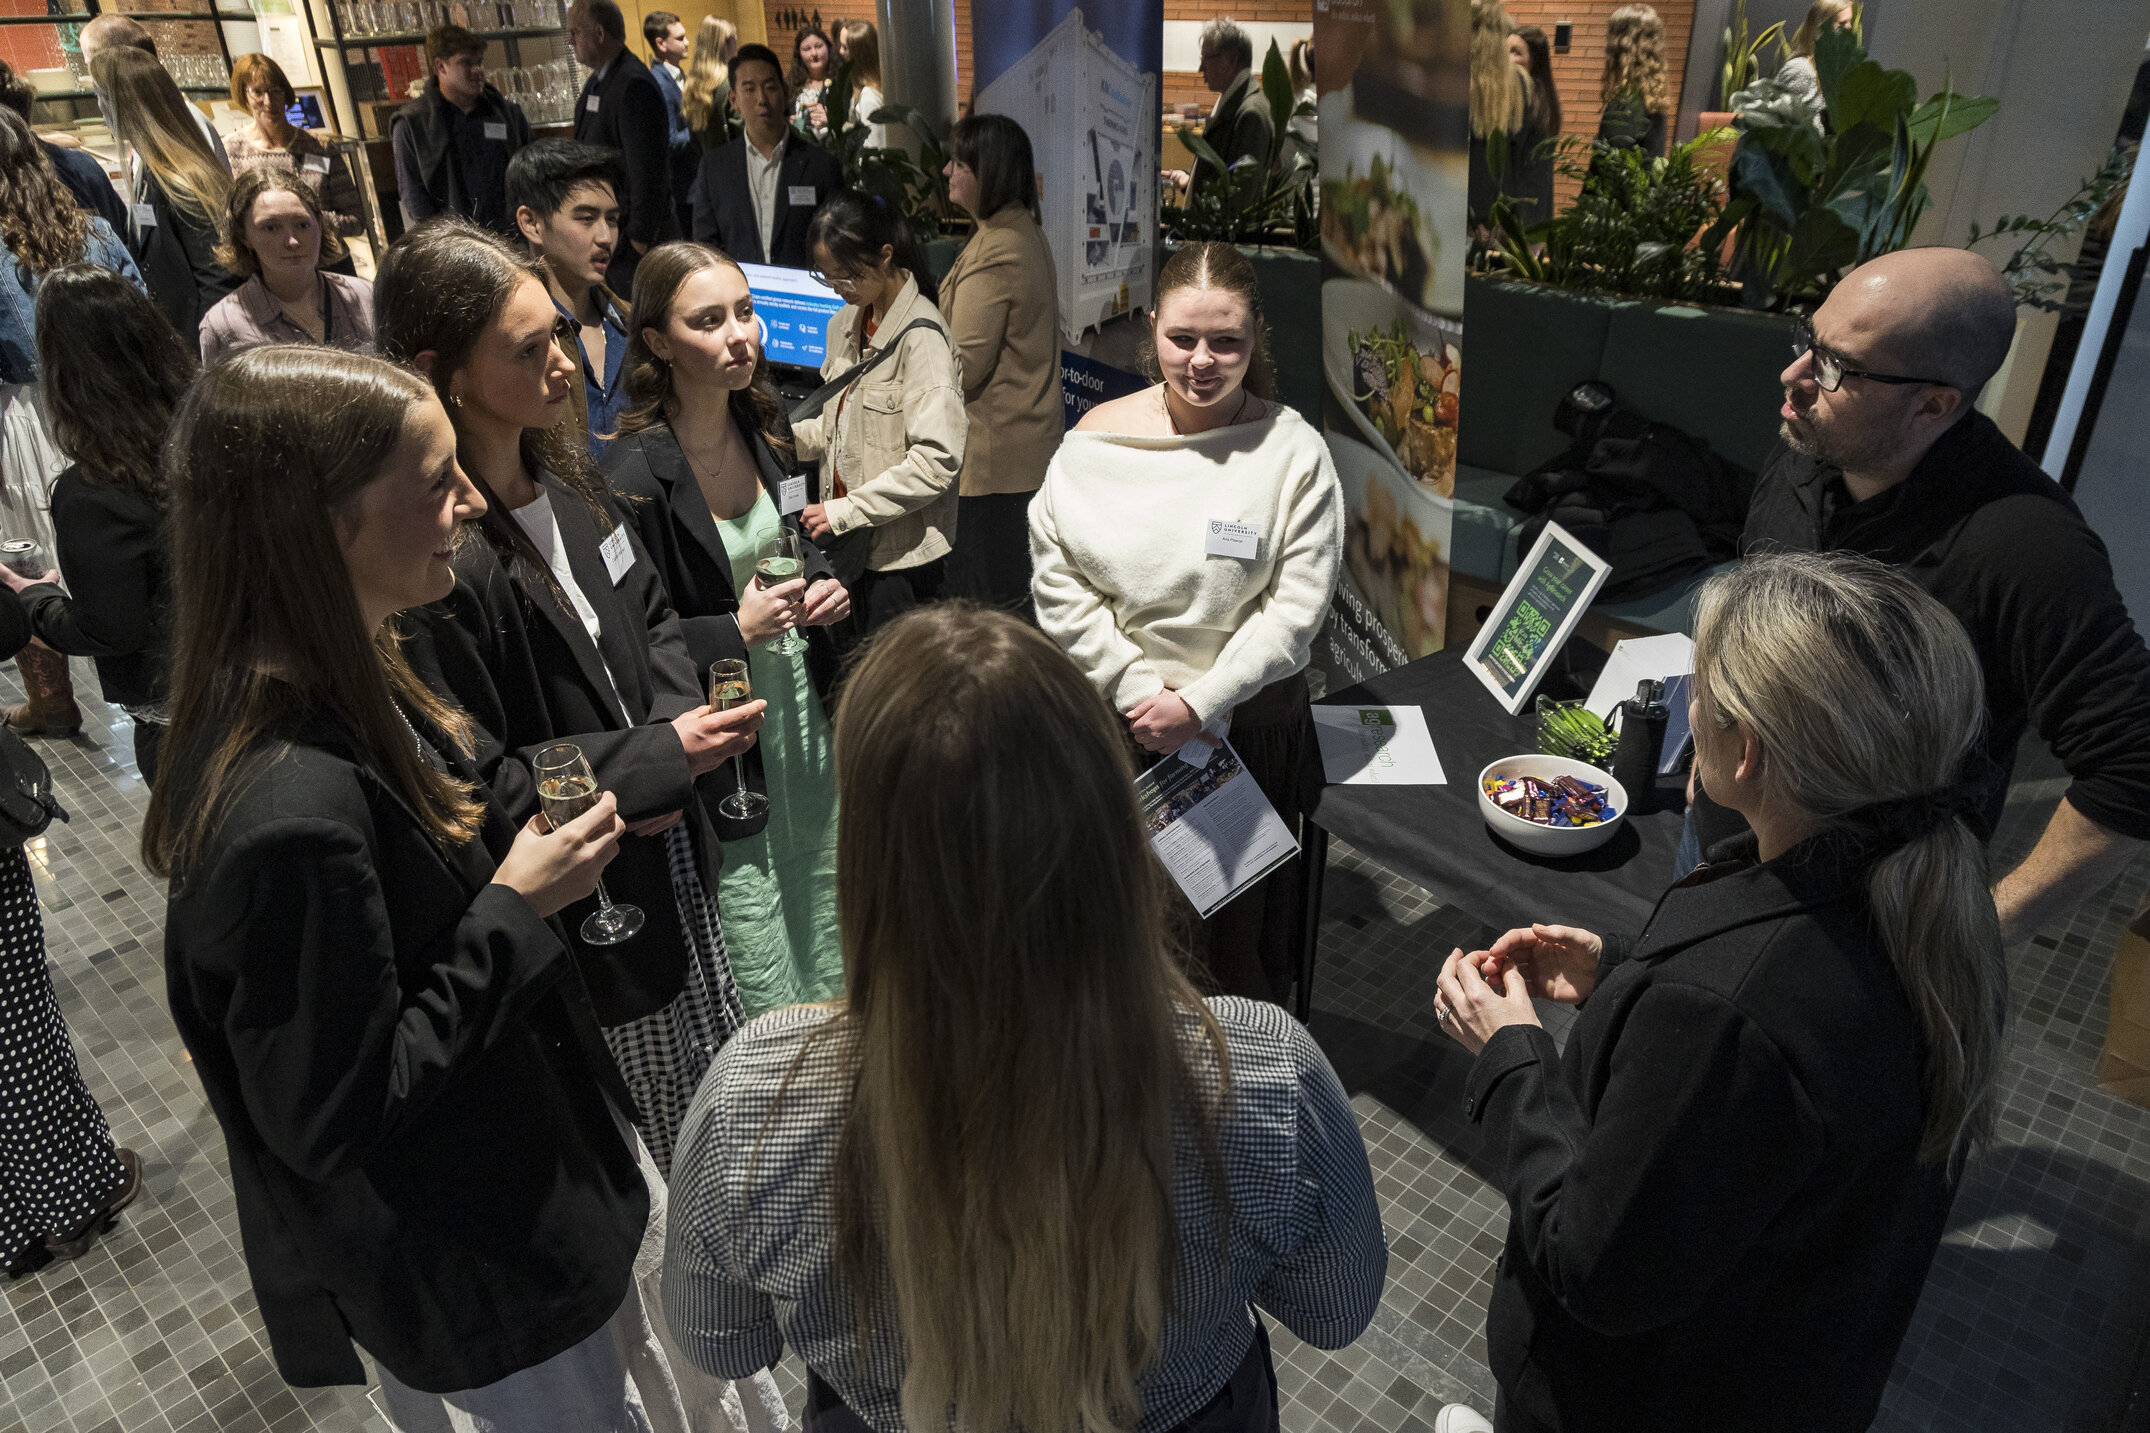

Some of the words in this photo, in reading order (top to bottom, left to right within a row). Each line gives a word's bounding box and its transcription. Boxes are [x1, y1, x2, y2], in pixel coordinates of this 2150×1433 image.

[1060, 366, 1104, 393] or-to-door
[1076, 395, 1099, 413] you
[1223, 528, 1257, 536] UNIVERSITY
[1338, 575, 1363, 624] iving
[1365, 609, 1410, 666] prosperit
[1329, 636, 1366, 684] agricult
[1340, 613, 1391, 675] transform
